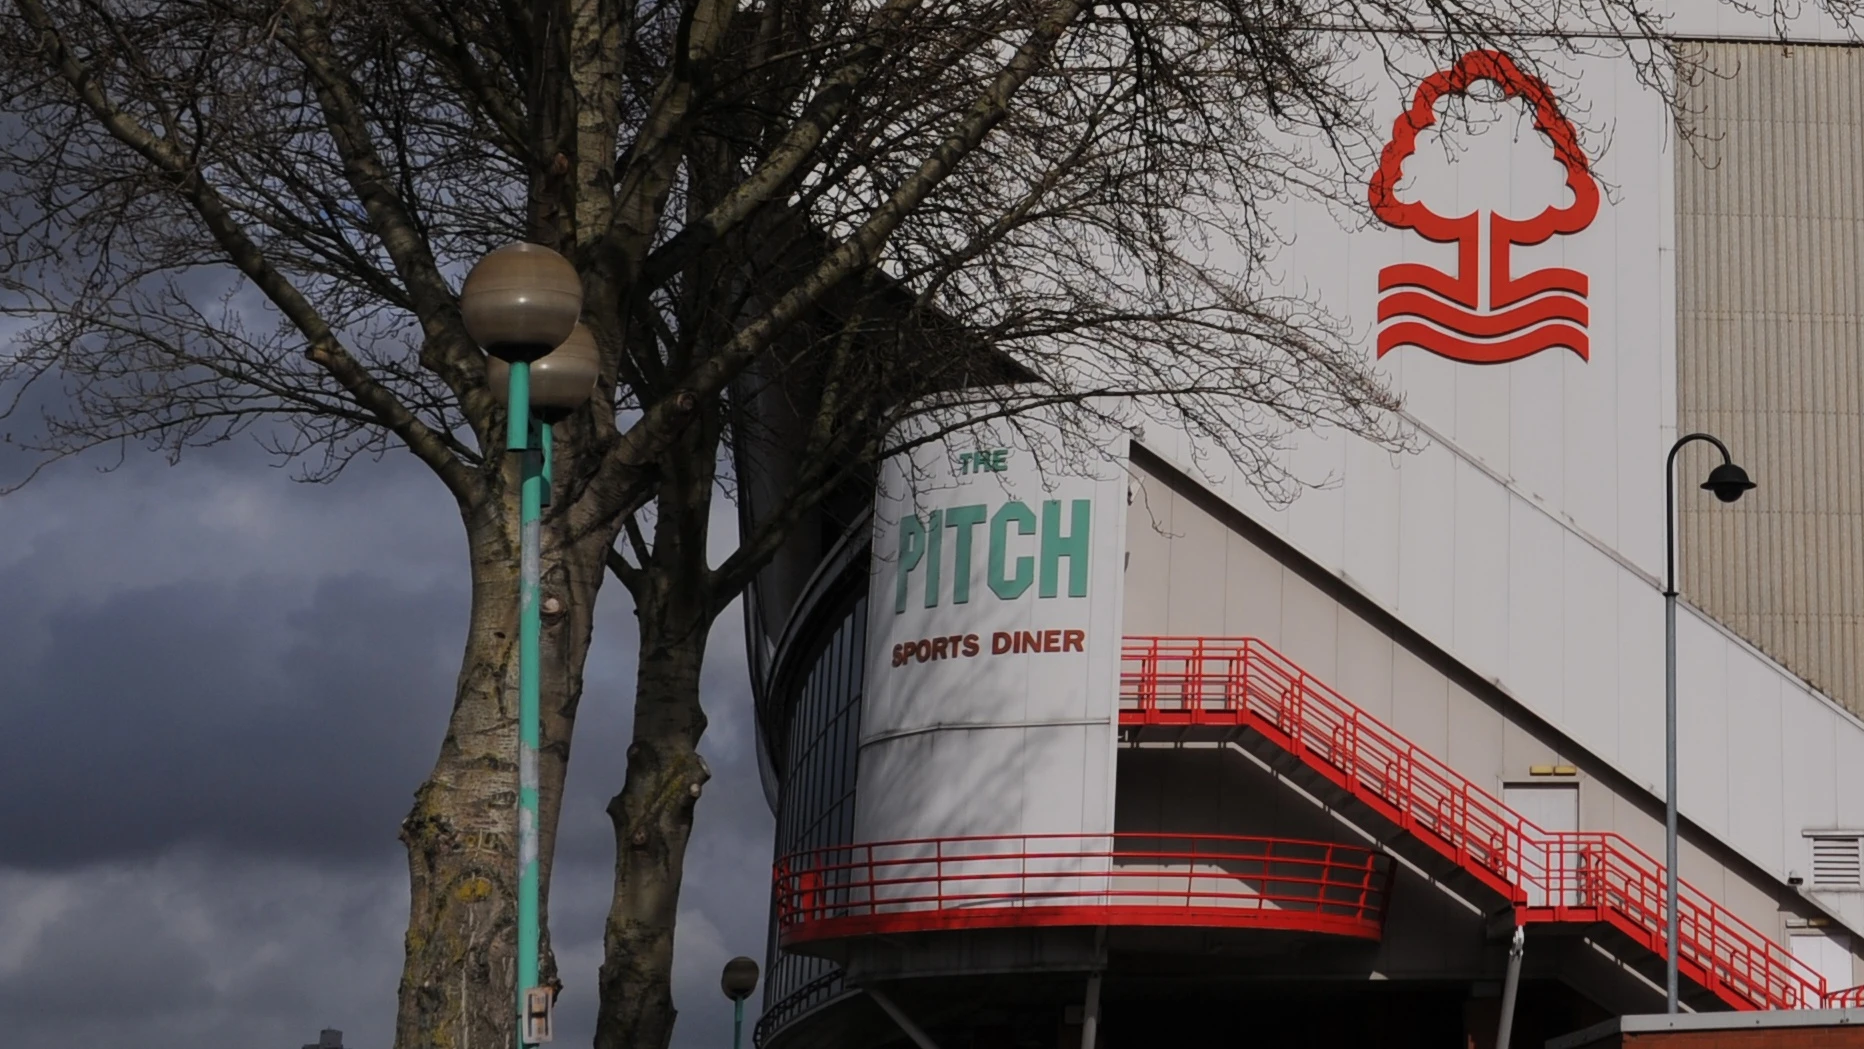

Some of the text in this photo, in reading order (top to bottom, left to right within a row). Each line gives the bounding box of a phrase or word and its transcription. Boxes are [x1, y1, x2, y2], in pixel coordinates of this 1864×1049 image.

[959, 449, 1009, 475] THE
[894, 498, 1092, 616] PITCH
[891, 629, 1086, 669] SPORTS DINER
